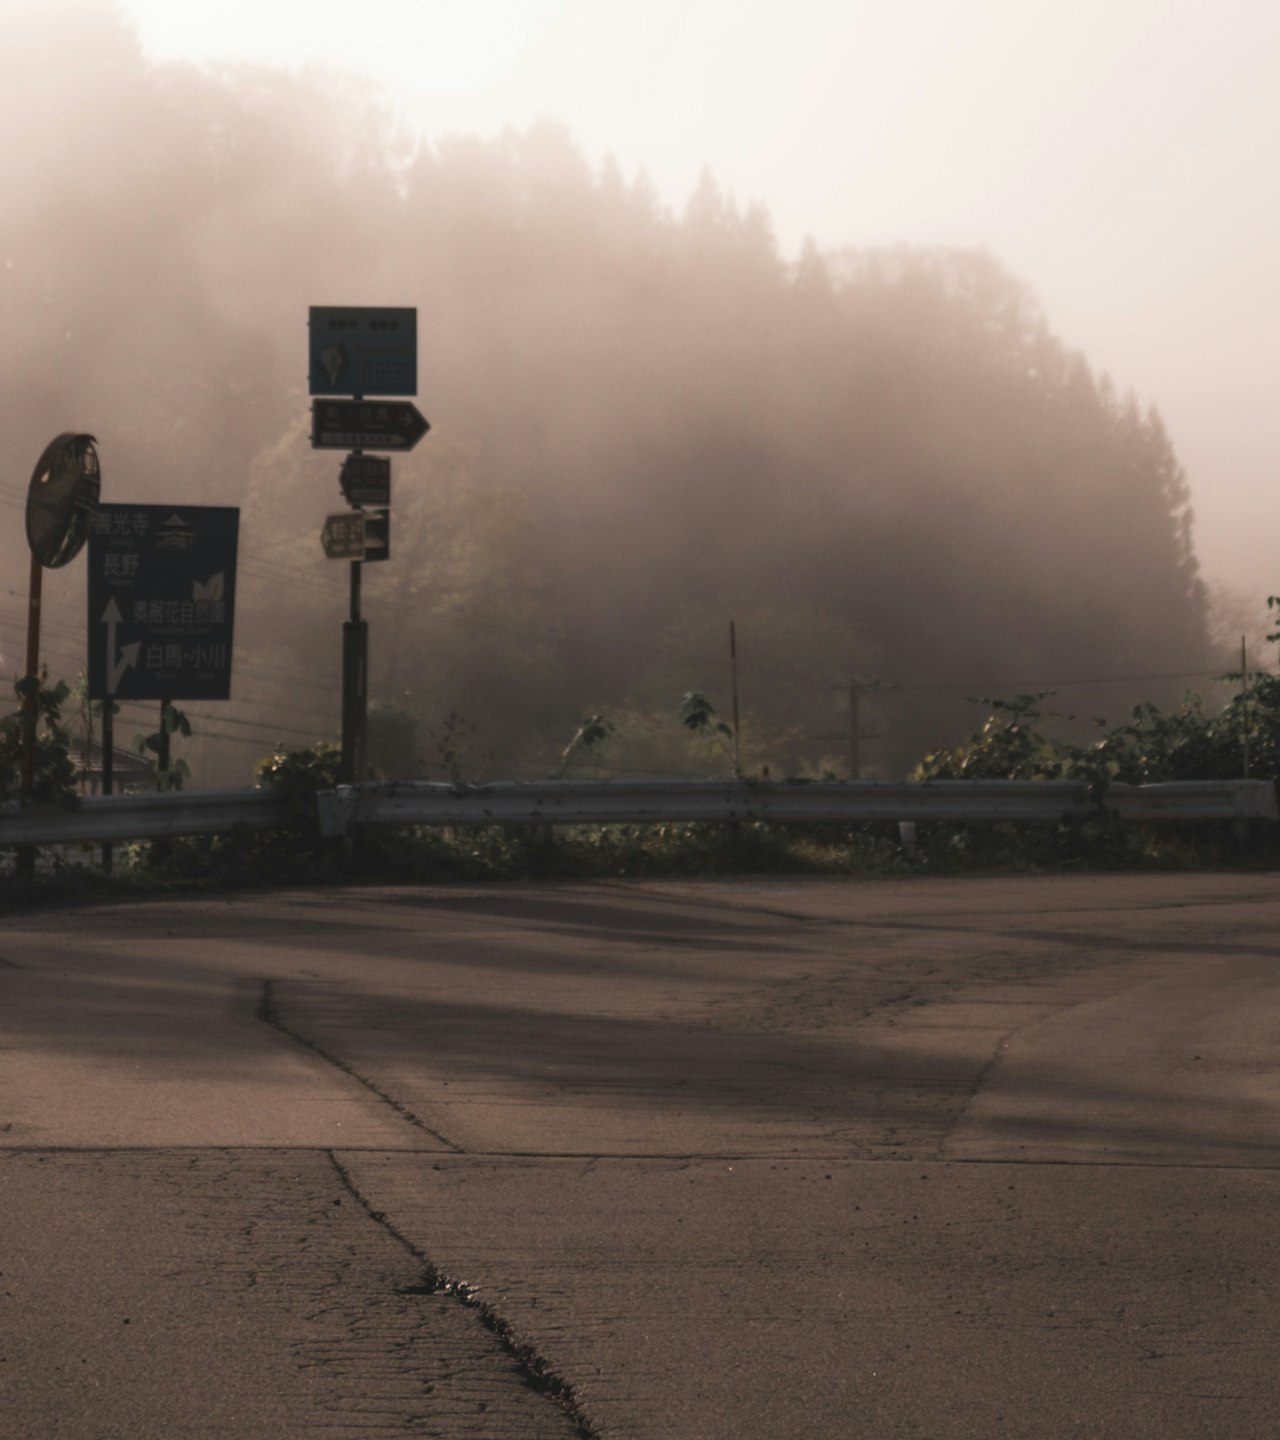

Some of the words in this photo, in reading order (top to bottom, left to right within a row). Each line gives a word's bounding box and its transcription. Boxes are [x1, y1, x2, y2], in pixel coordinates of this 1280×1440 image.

[104, 554, 139, 577] 長野
[146, 643, 225, 669] 白馬・小川
